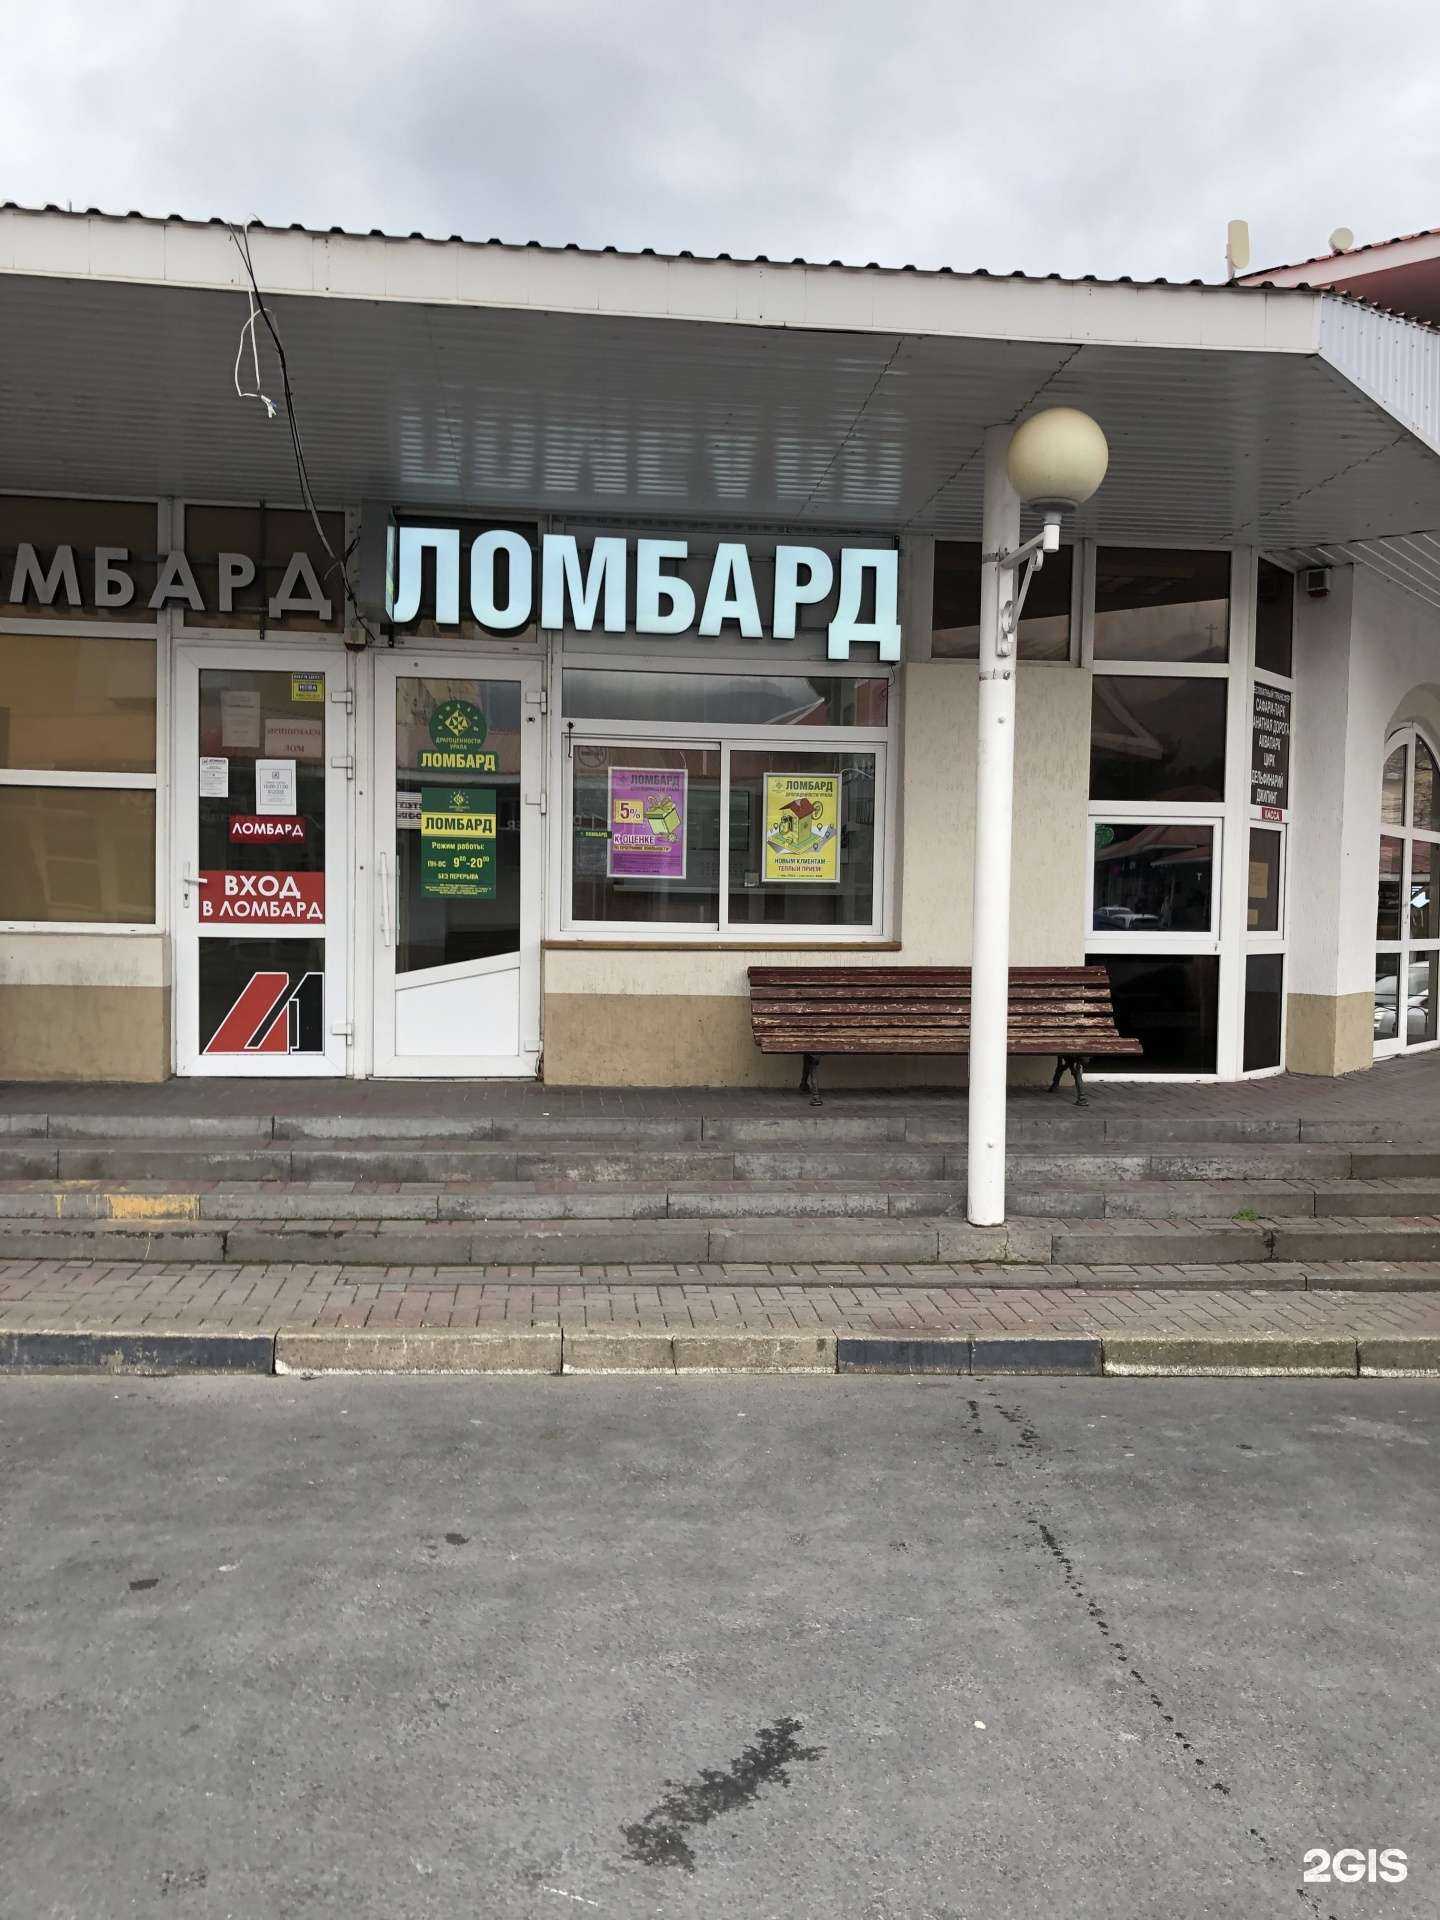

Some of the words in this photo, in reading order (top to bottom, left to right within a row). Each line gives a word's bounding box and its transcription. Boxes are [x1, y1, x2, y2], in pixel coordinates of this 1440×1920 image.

[8, 542, 333, 621] МБАРД
[391, 527, 902, 662] ЛОМБАРД
[421, 752, 496, 772] ЛОМБАРД
[630, 774, 680, 786] ЛОМБАРД
[785, 780, 834, 793] ЛОМБАРД
[619, 802, 641, 820] 5%
[232, 822, 304, 838] ЛОМБАРД
[425, 817, 493, 834] ЛОМБАРД
[431, 841, 456, 850] Режим
[457, 843, 485, 851] работы:
[622, 835, 655, 845] ОЦЕНКЕ
[224, 875, 301, 900] ВХОД
[202, 902, 214, 917] В
[219, 901, 324, 920] ЛОМБАРД
